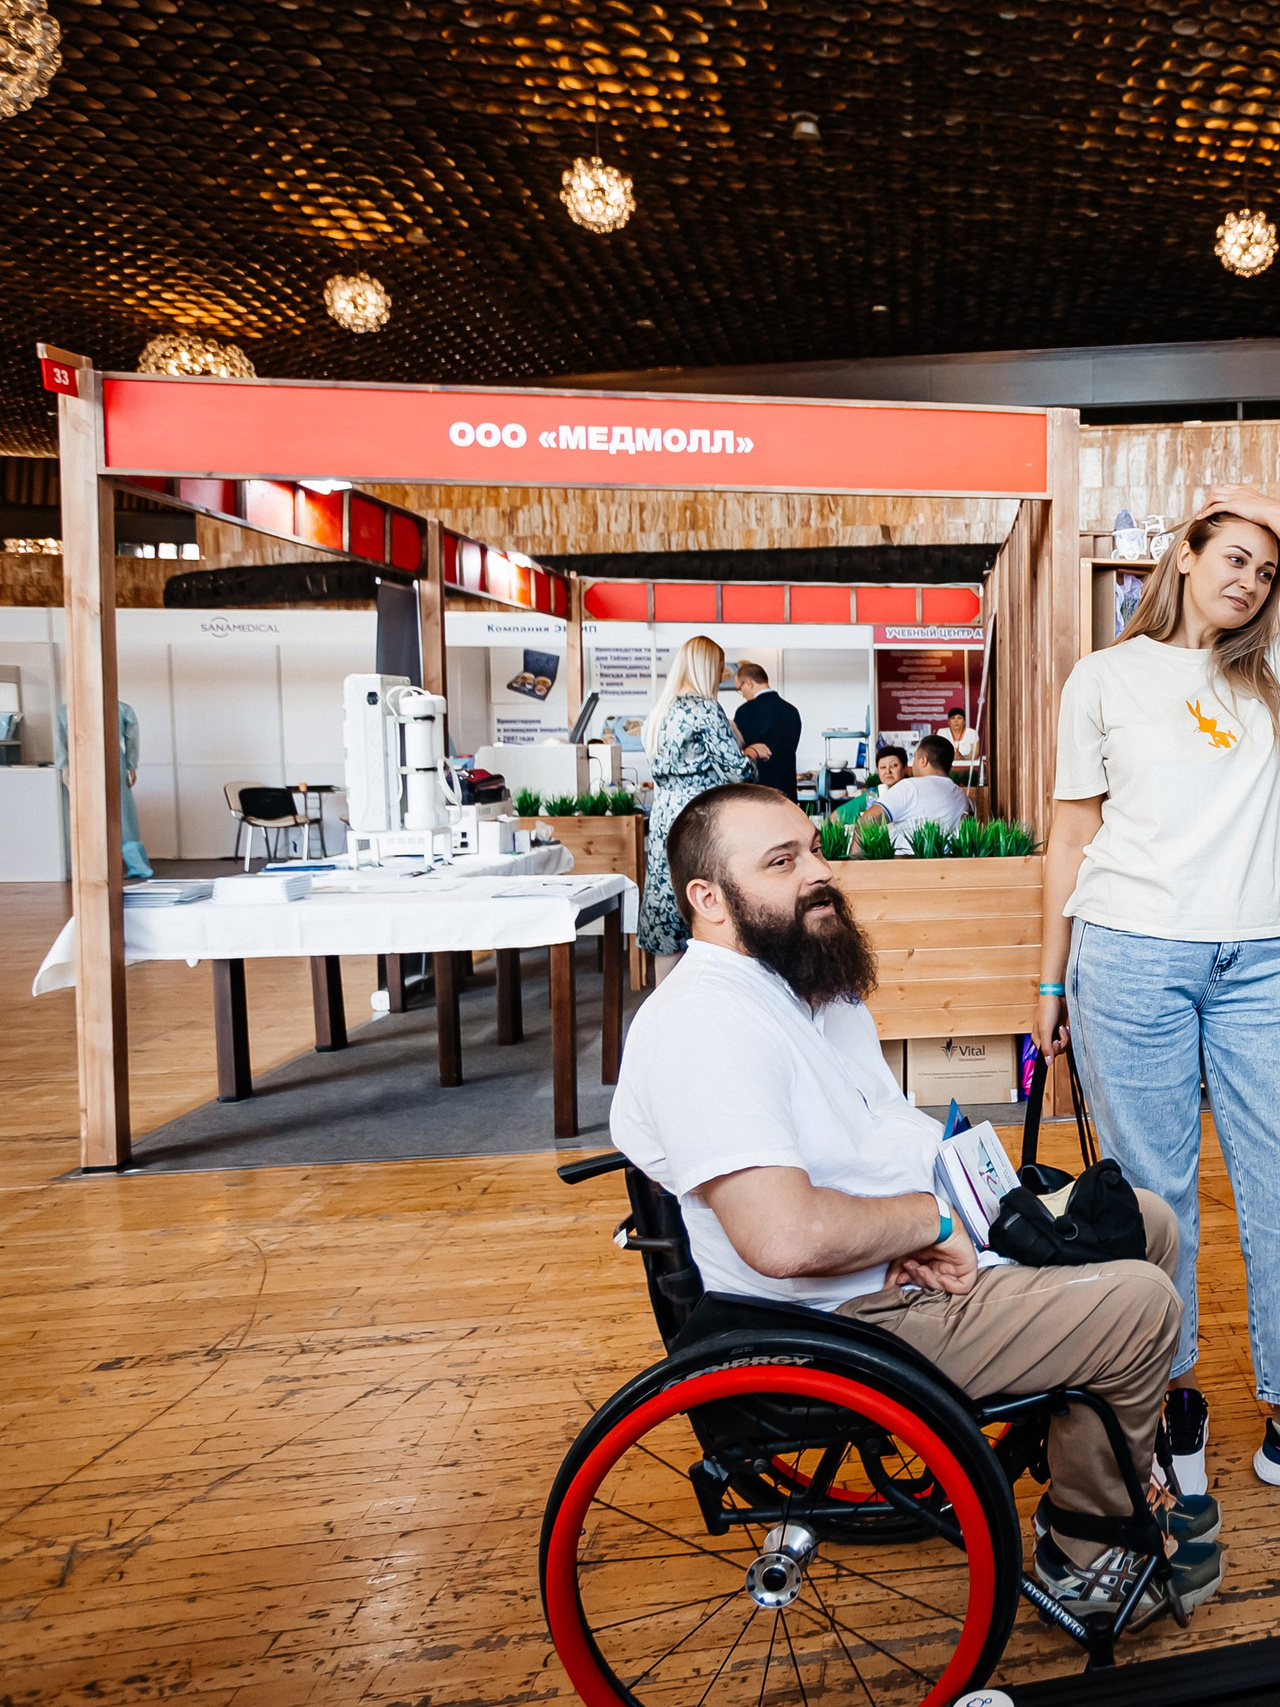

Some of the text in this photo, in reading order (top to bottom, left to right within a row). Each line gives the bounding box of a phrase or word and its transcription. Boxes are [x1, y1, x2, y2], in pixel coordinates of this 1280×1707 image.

[53, 367, 70, 386] 33
[448, 421, 755, 455] ООО «МЕДМОЛЛ»
[200, 623, 281, 634] SANAMEDICAL
[886, 626, 937, 638] УЧЕБНЫЙ
[939, 628, 973, 639] ЦЕНТР
[958, 1044, 986, 1057] Vital
